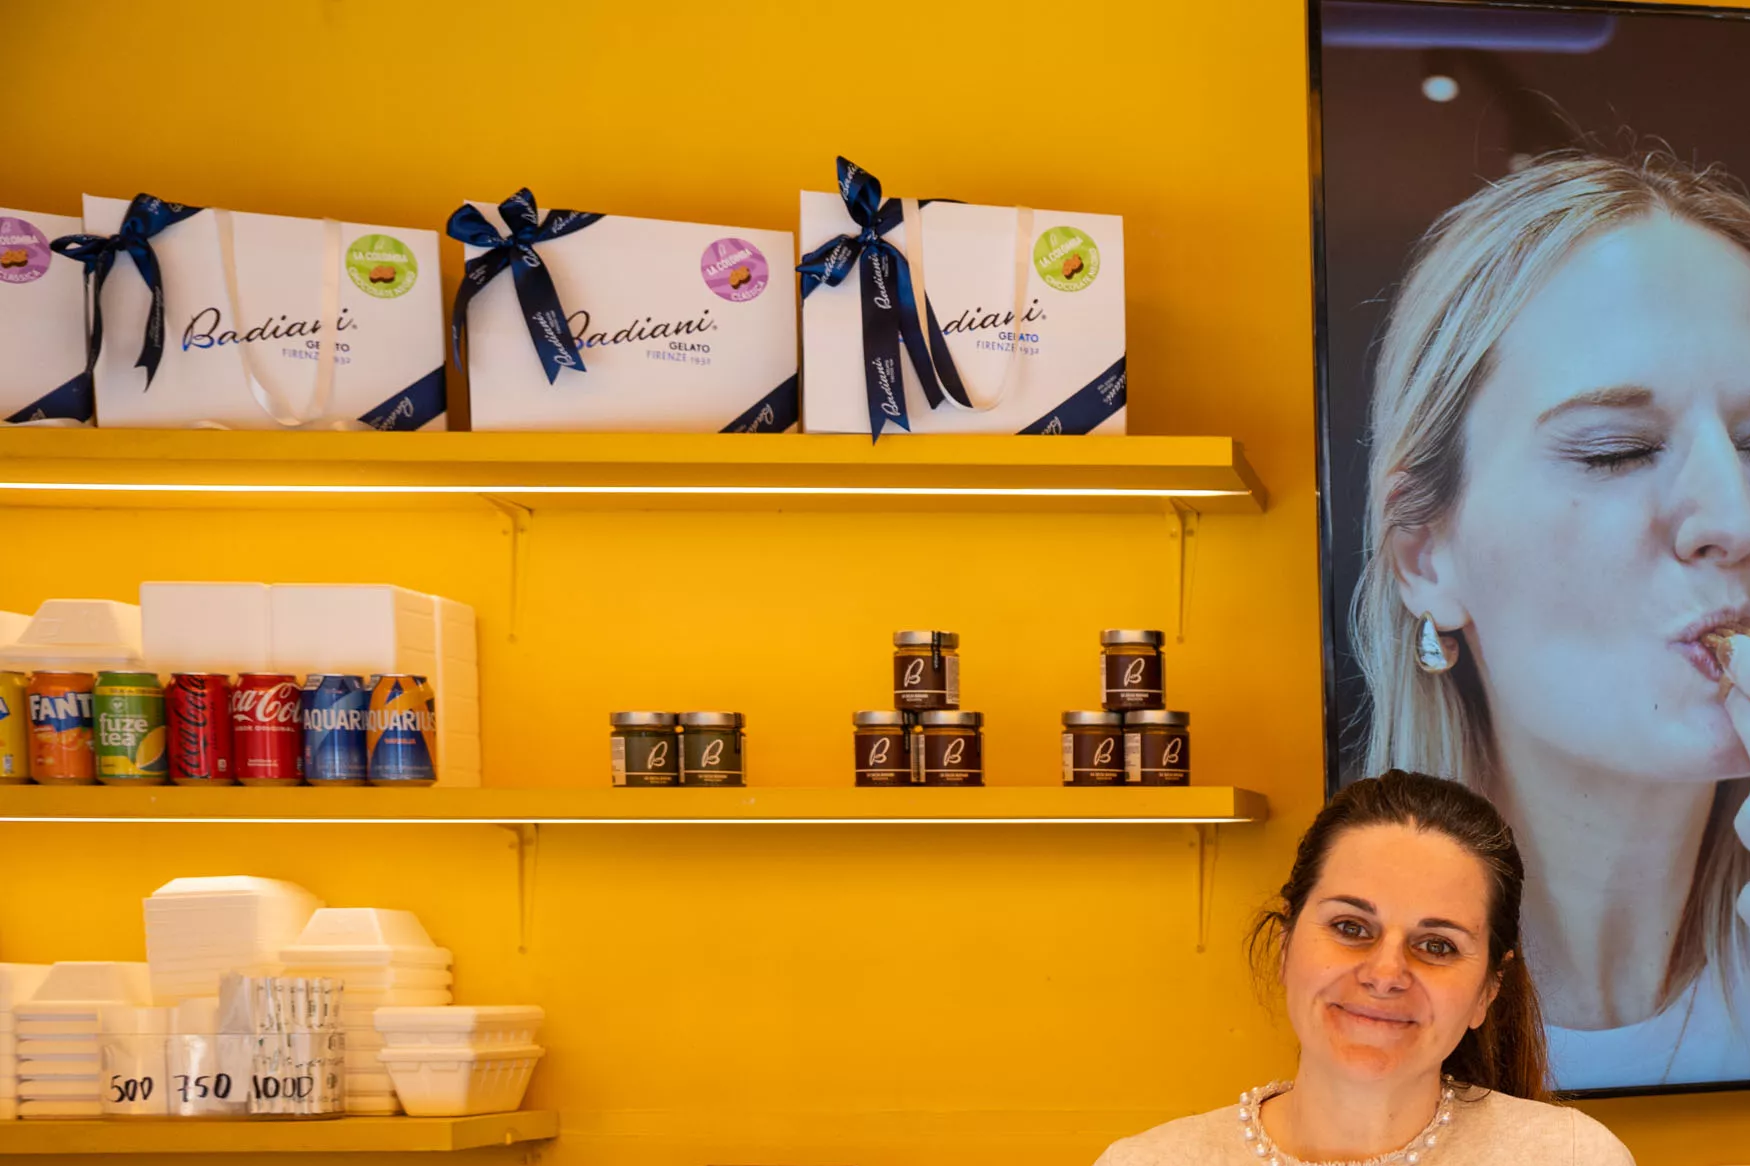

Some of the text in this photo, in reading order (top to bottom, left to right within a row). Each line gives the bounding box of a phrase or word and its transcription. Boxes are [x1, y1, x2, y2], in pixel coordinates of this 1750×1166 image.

[942, 299, 1044, 335] diani
[566, 309, 714, 350] Badiani
[282, 348, 320, 361] FIRENZ
[306, 340, 351, 352] GETO
[646, 350, 687, 362] FIRENZE
[669, 341, 711, 353] GELATO
[976, 340, 1016, 352] FIRENZE
[872, 357, 901, 416] Badiani
[29, 692, 93, 721] FANT
[99, 712, 148, 733] fuze
[303, 708, 365, 731] AQUARI
[368, 708, 436, 732] QUARIUS
[99, 732, 137, 747] tea
[110, 1073, 314, 1103] 500 750 1000
